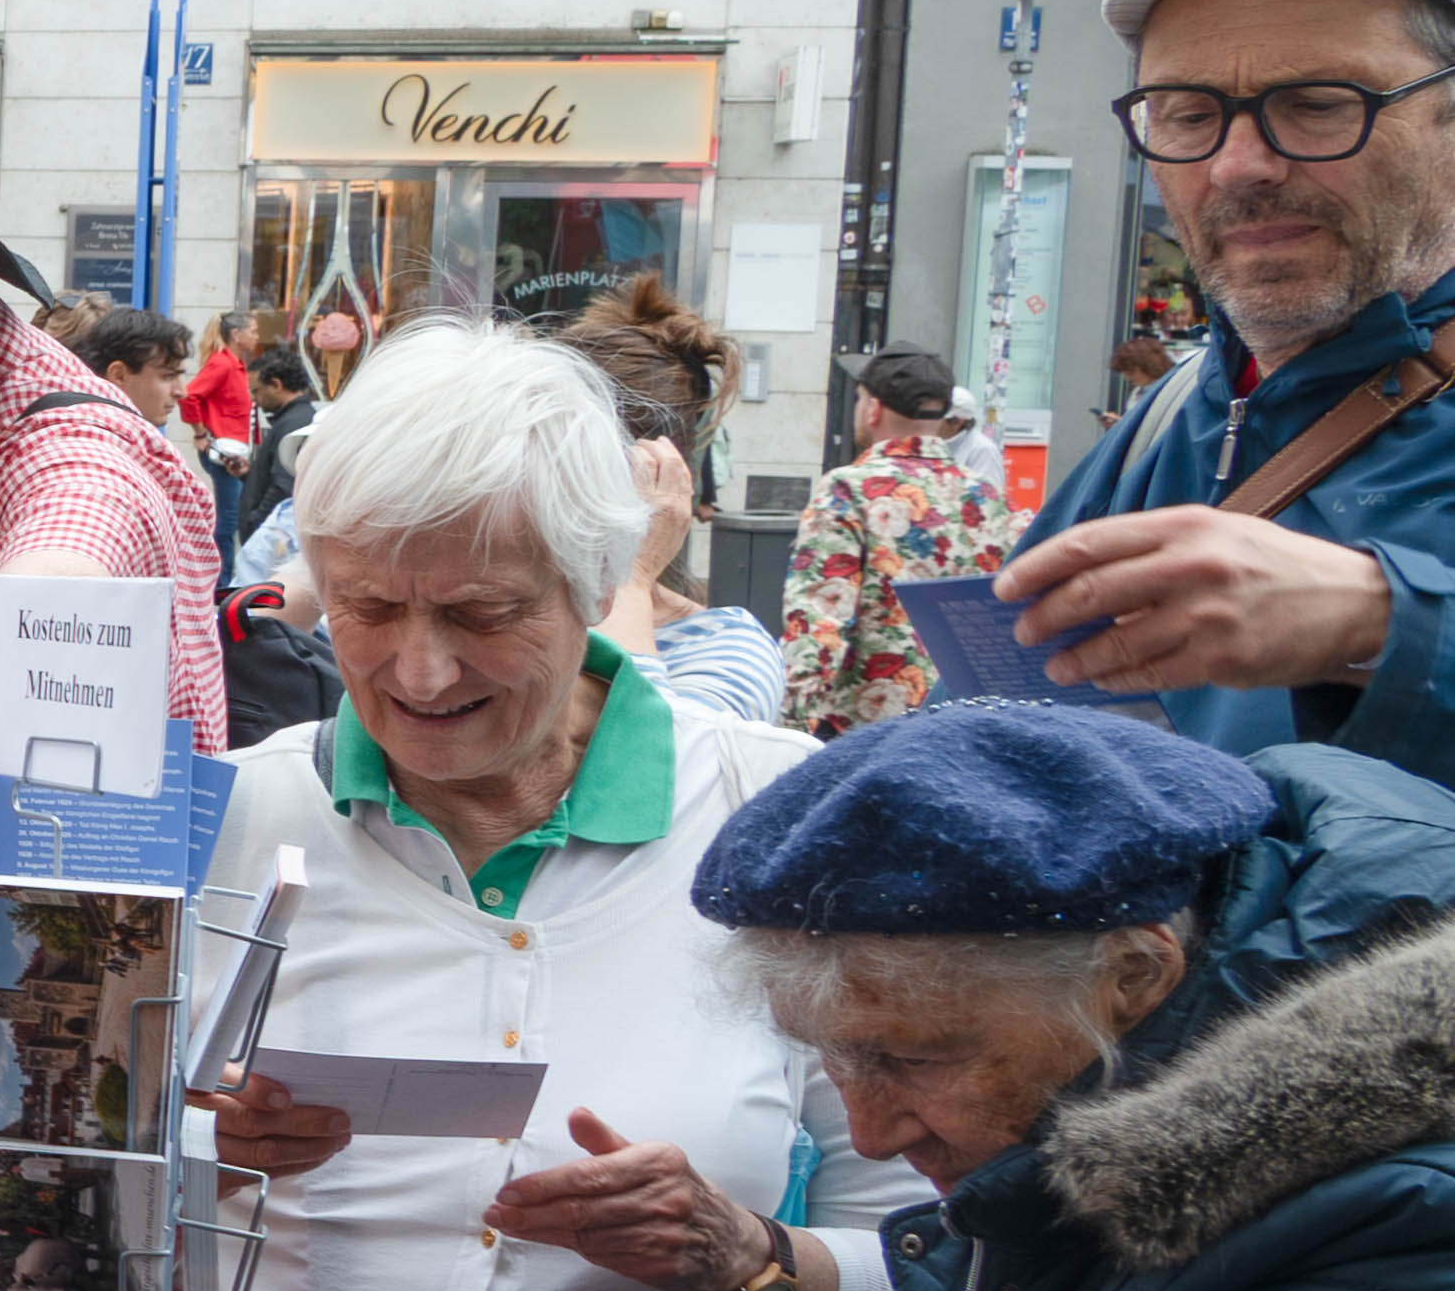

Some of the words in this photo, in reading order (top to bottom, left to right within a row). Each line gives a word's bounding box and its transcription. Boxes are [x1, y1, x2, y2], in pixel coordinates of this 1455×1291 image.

[381, 72, 578, 145] Venchi
[17, 609, 93, 646] Kostenlos
[98, 622, 132, 648] zum
[25, 669, 115, 710] Mitnehmen
